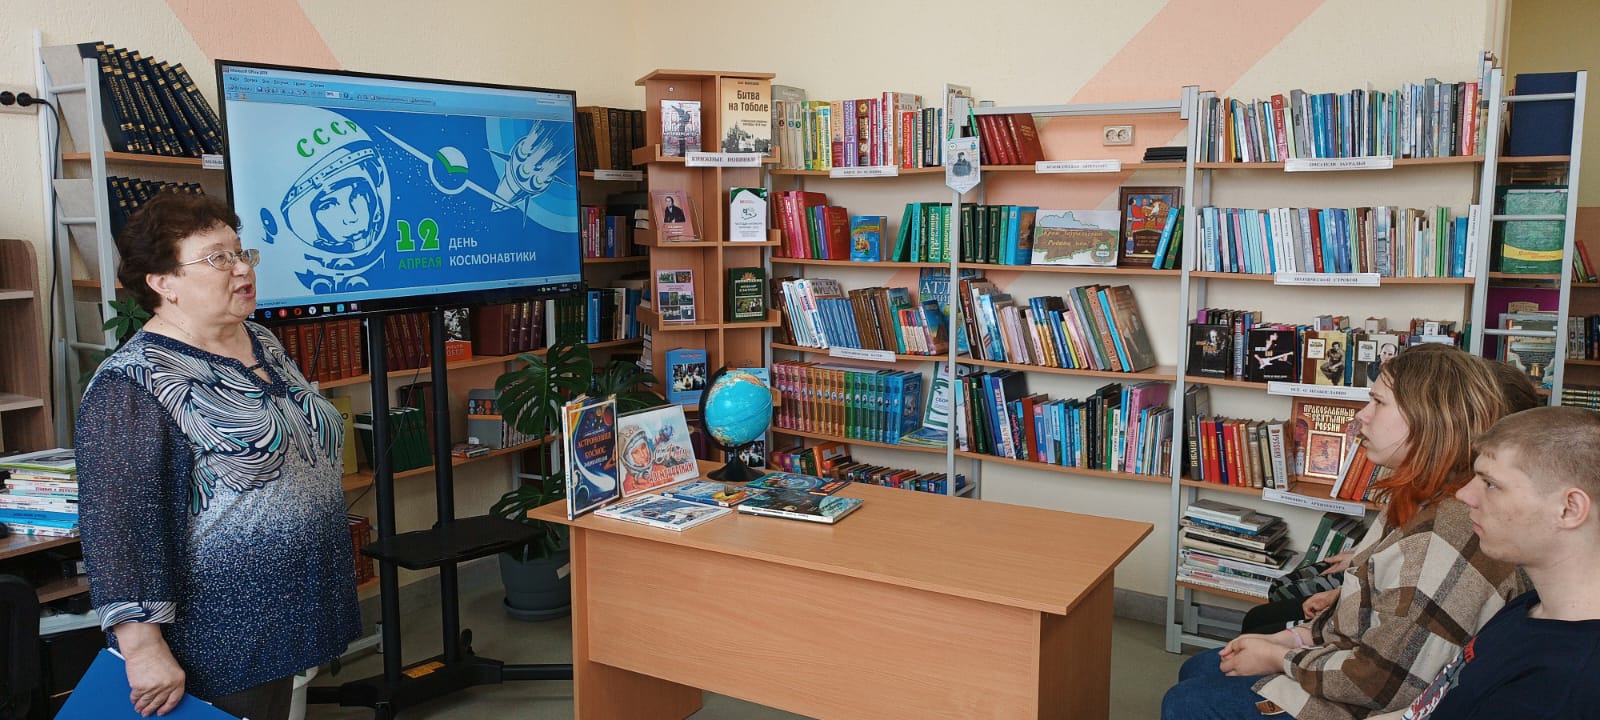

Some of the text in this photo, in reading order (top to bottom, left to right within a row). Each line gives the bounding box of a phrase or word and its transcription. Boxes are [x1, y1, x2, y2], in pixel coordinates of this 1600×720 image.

[737, 90, 760, 100] Битва
[728, 101, 769, 112] на Тоболе
[396, 217, 440, 252] 12
[448, 237, 478, 250] ДЕНЬ
[399, 256, 442, 270] АПРЕЛЯ
[449, 251, 537, 267] КОСМОНАВТИКИ
[921, 280, 951, 295] АТЛ
[1303, 404, 1356, 417] ПРАВОСЛАВНЫЕ
[1311, 413, 1346, 425] СВЯТЫНИ
[1314, 421, 1341, 433] РОССИИ
[577, 431, 612, 449] АСТРОНОМИЯ
[584, 446, 606, 460] КОСМОС
